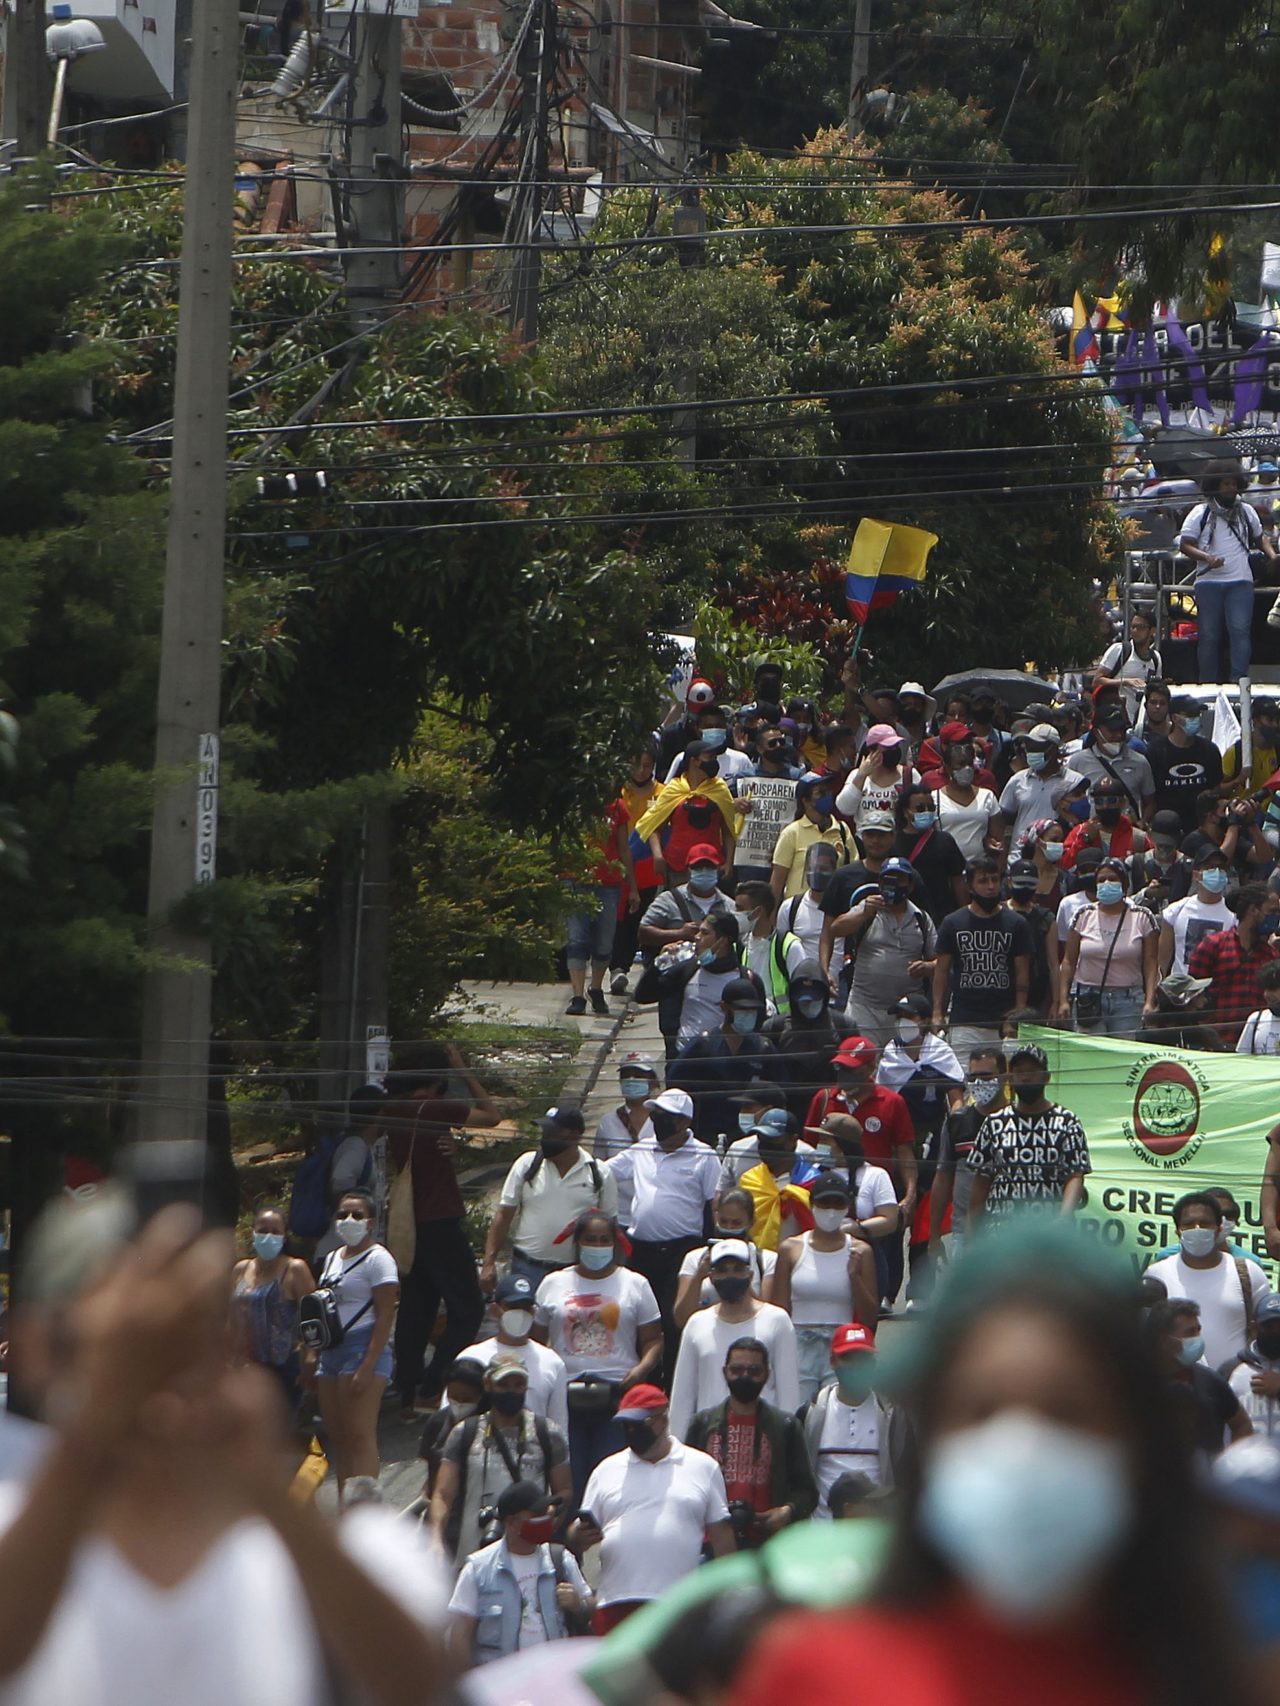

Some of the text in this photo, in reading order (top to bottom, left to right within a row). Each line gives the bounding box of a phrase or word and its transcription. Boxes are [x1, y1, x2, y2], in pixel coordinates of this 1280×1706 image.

[1185, 320, 1242, 351] DEL
[754, 782, 796, 798] DISPAREN
[956, 930, 1013, 953] RUN
[960, 951, 1009, 972] THIS
[959, 971, 1010, 989] ROAD
[1121, 1120, 1161, 1168] SECCIONAL
[1103, 1187, 1175, 1216] CRE
